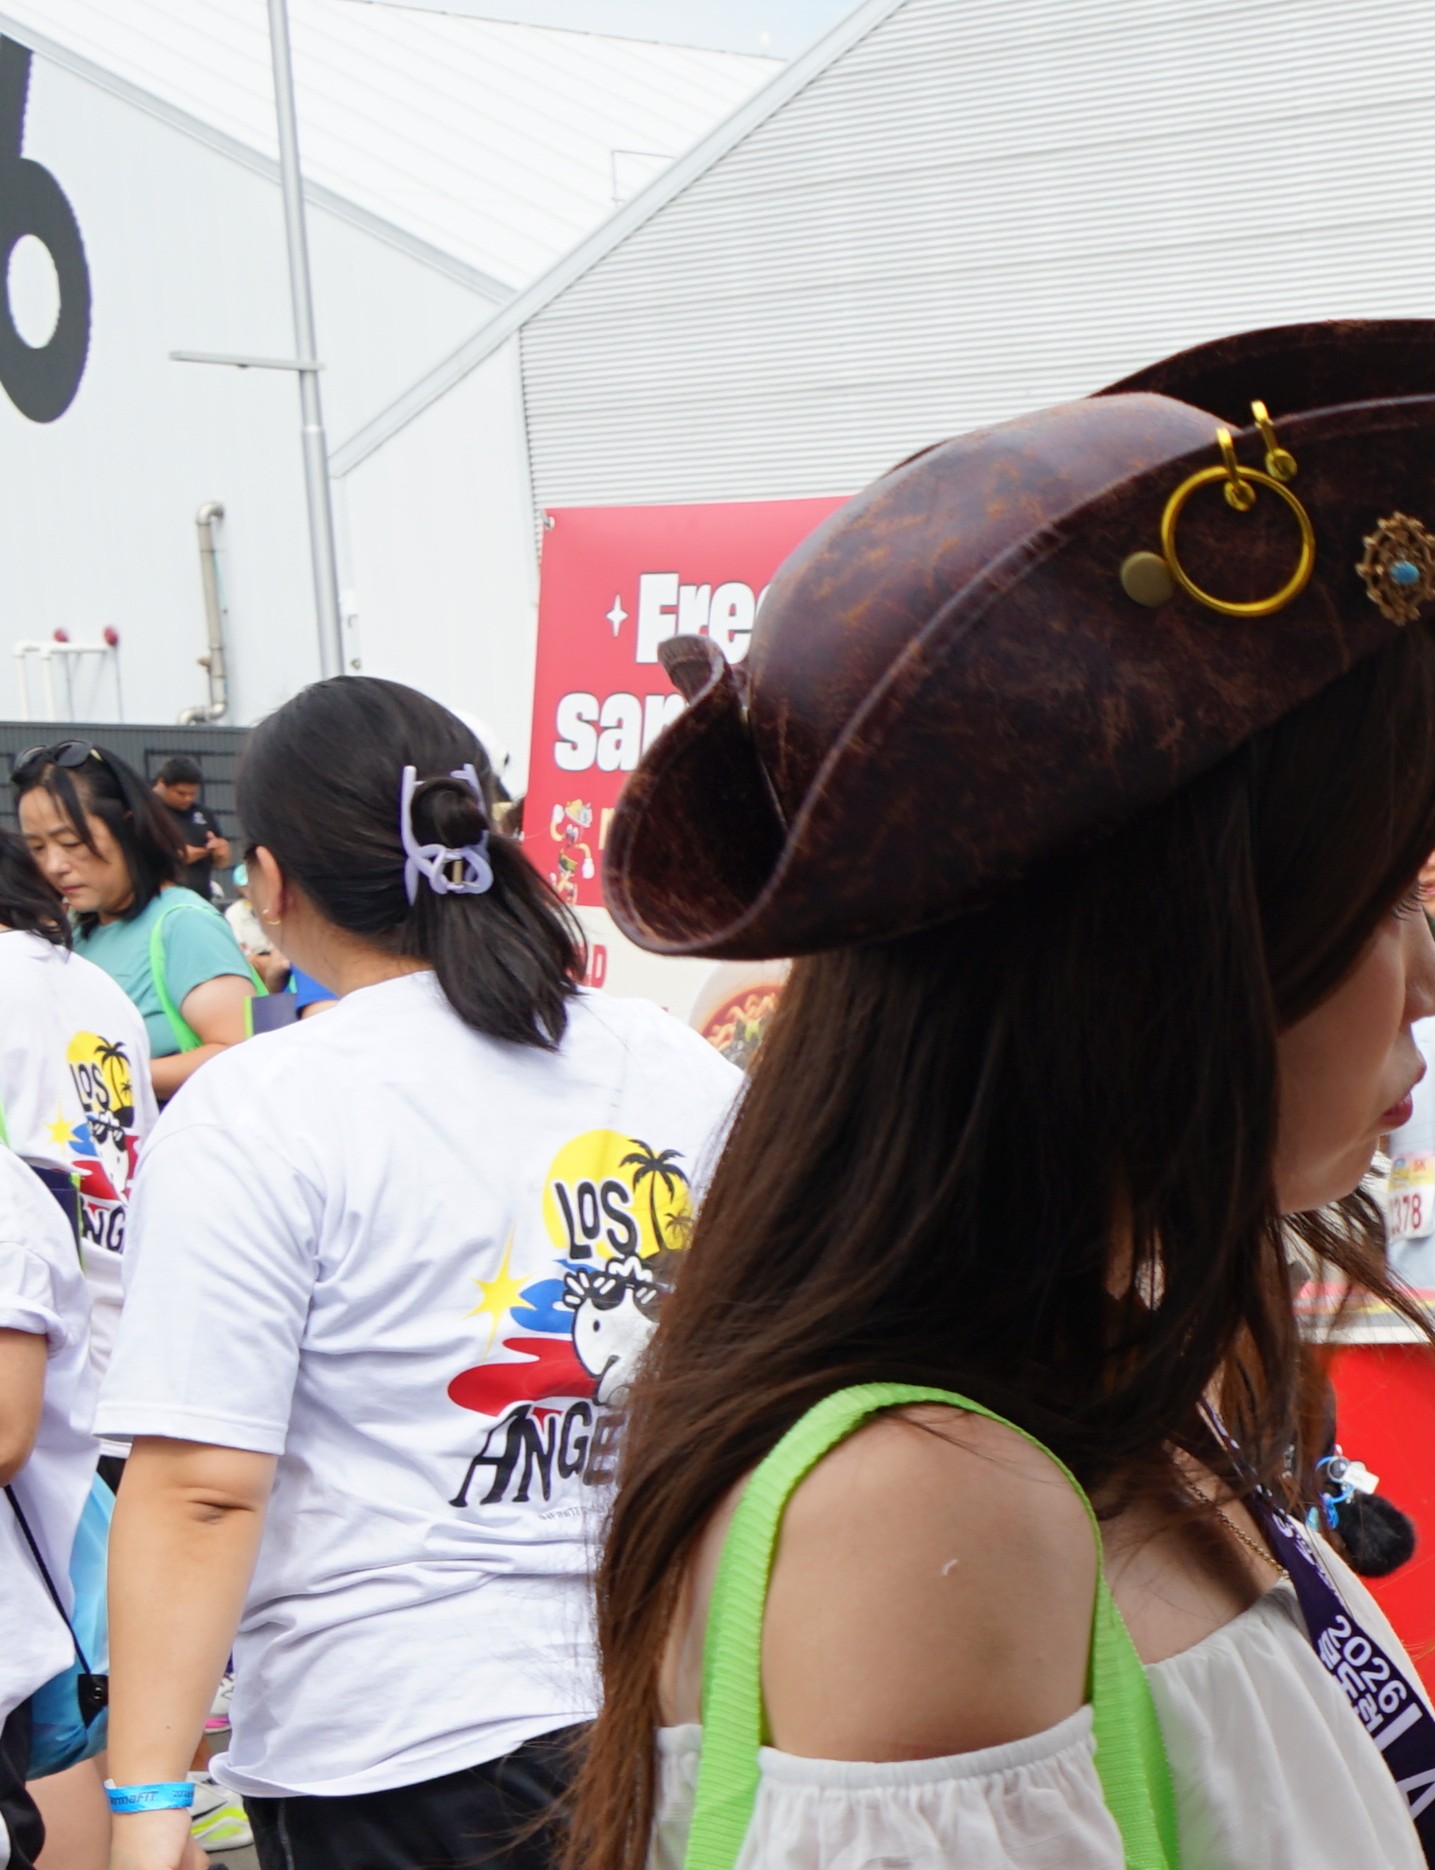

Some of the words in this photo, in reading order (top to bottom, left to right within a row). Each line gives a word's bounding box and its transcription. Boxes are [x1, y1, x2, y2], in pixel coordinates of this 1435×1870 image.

[636, 572, 770, 664] Fre
[70, 1063, 109, 1112] LOS
[555, 1180, 637, 1260] LOS
[1326, 1614, 1407, 1714] 2026
